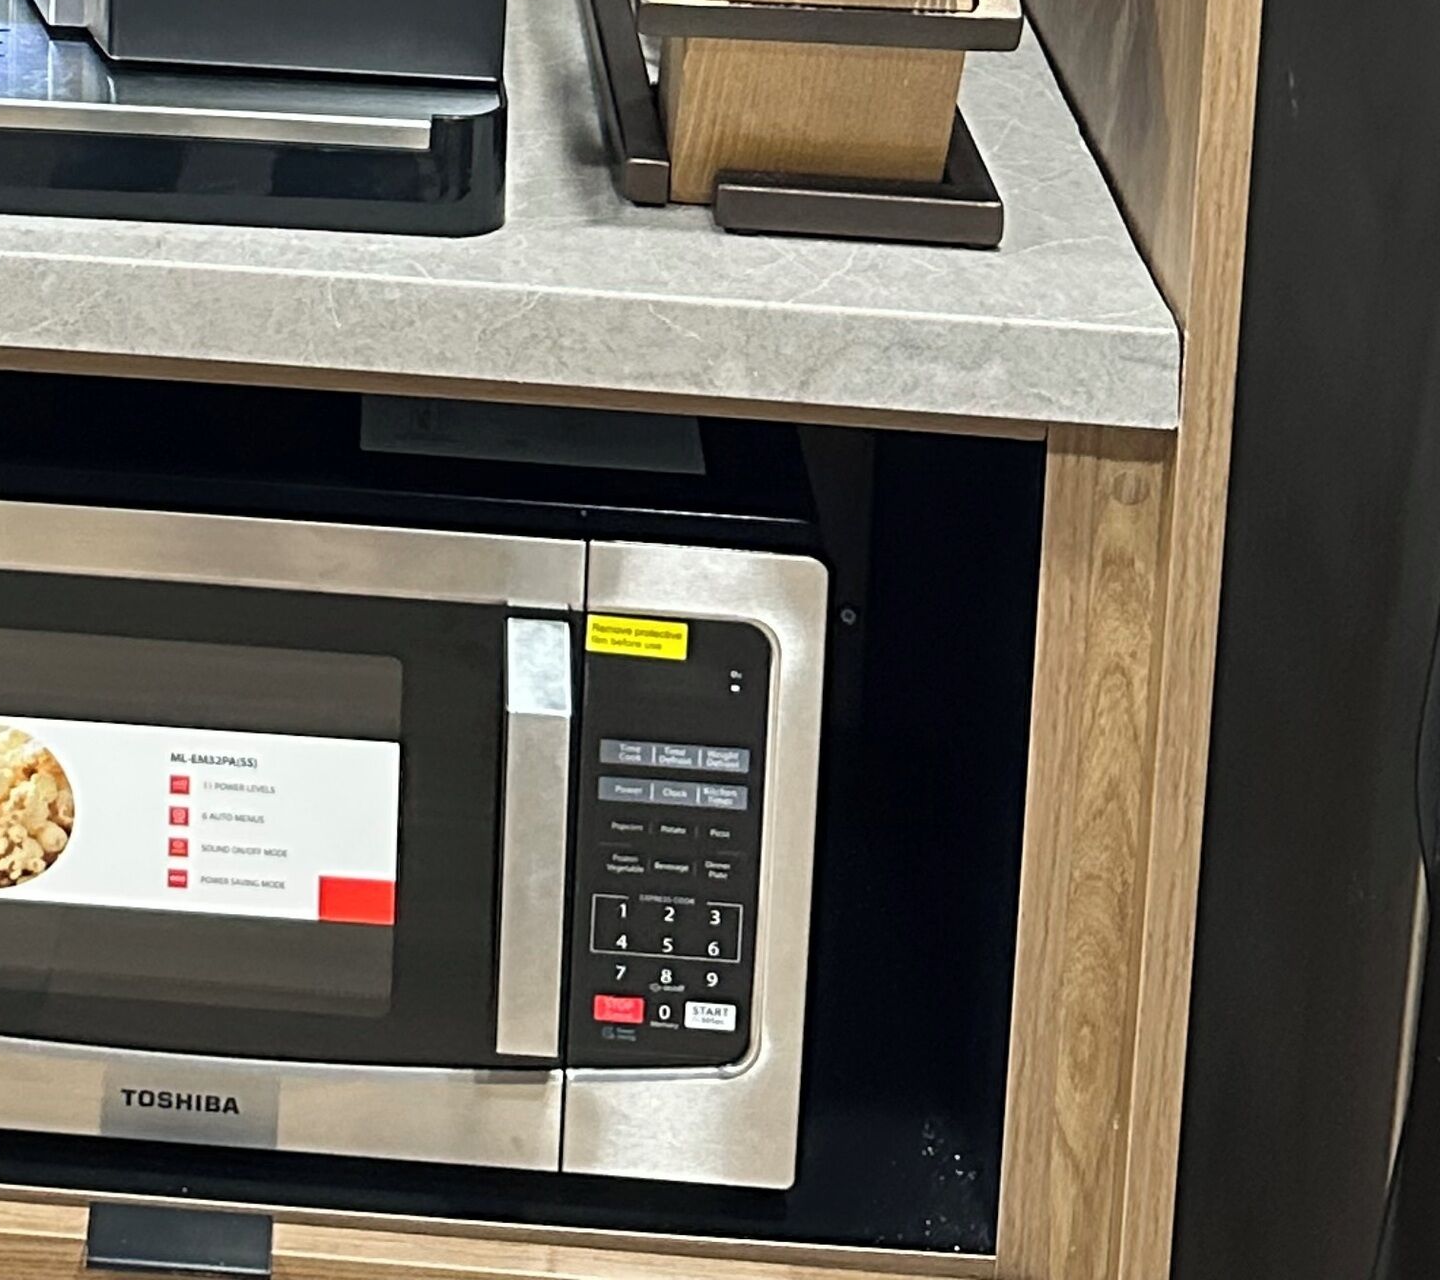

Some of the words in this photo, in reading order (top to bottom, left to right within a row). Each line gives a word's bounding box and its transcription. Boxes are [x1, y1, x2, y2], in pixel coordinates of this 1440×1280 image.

[592, 623, 633, 635] Remove
[634, 628, 682, 640] protective
[610, 638, 641, 649] before
[644, 642, 663, 650] use
[214, 782, 244, 792] POWER
[246, 784, 276, 794] LEVELS
[209, 813, 233, 822] AUTO
[263, 848, 288, 858] MODE
[261, 880, 286, 890] MODE
[619, 903, 627, 918] 1
[664, 906, 675, 922] 2
[709, 910, 721, 925] 3
[616, 934, 628, 949] 4
[662, 938, 673, 953] 5
[707, 941, 720, 956] 6
[616, 965, 626, 981] 7
[660, 969, 672, 984] 8
[706, 972, 719, 987] 9
[658, 1005, 671, 1020] 0
[692, 1005, 729, 1017] START
[121, 1088, 240, 1115] TOSHIBA
